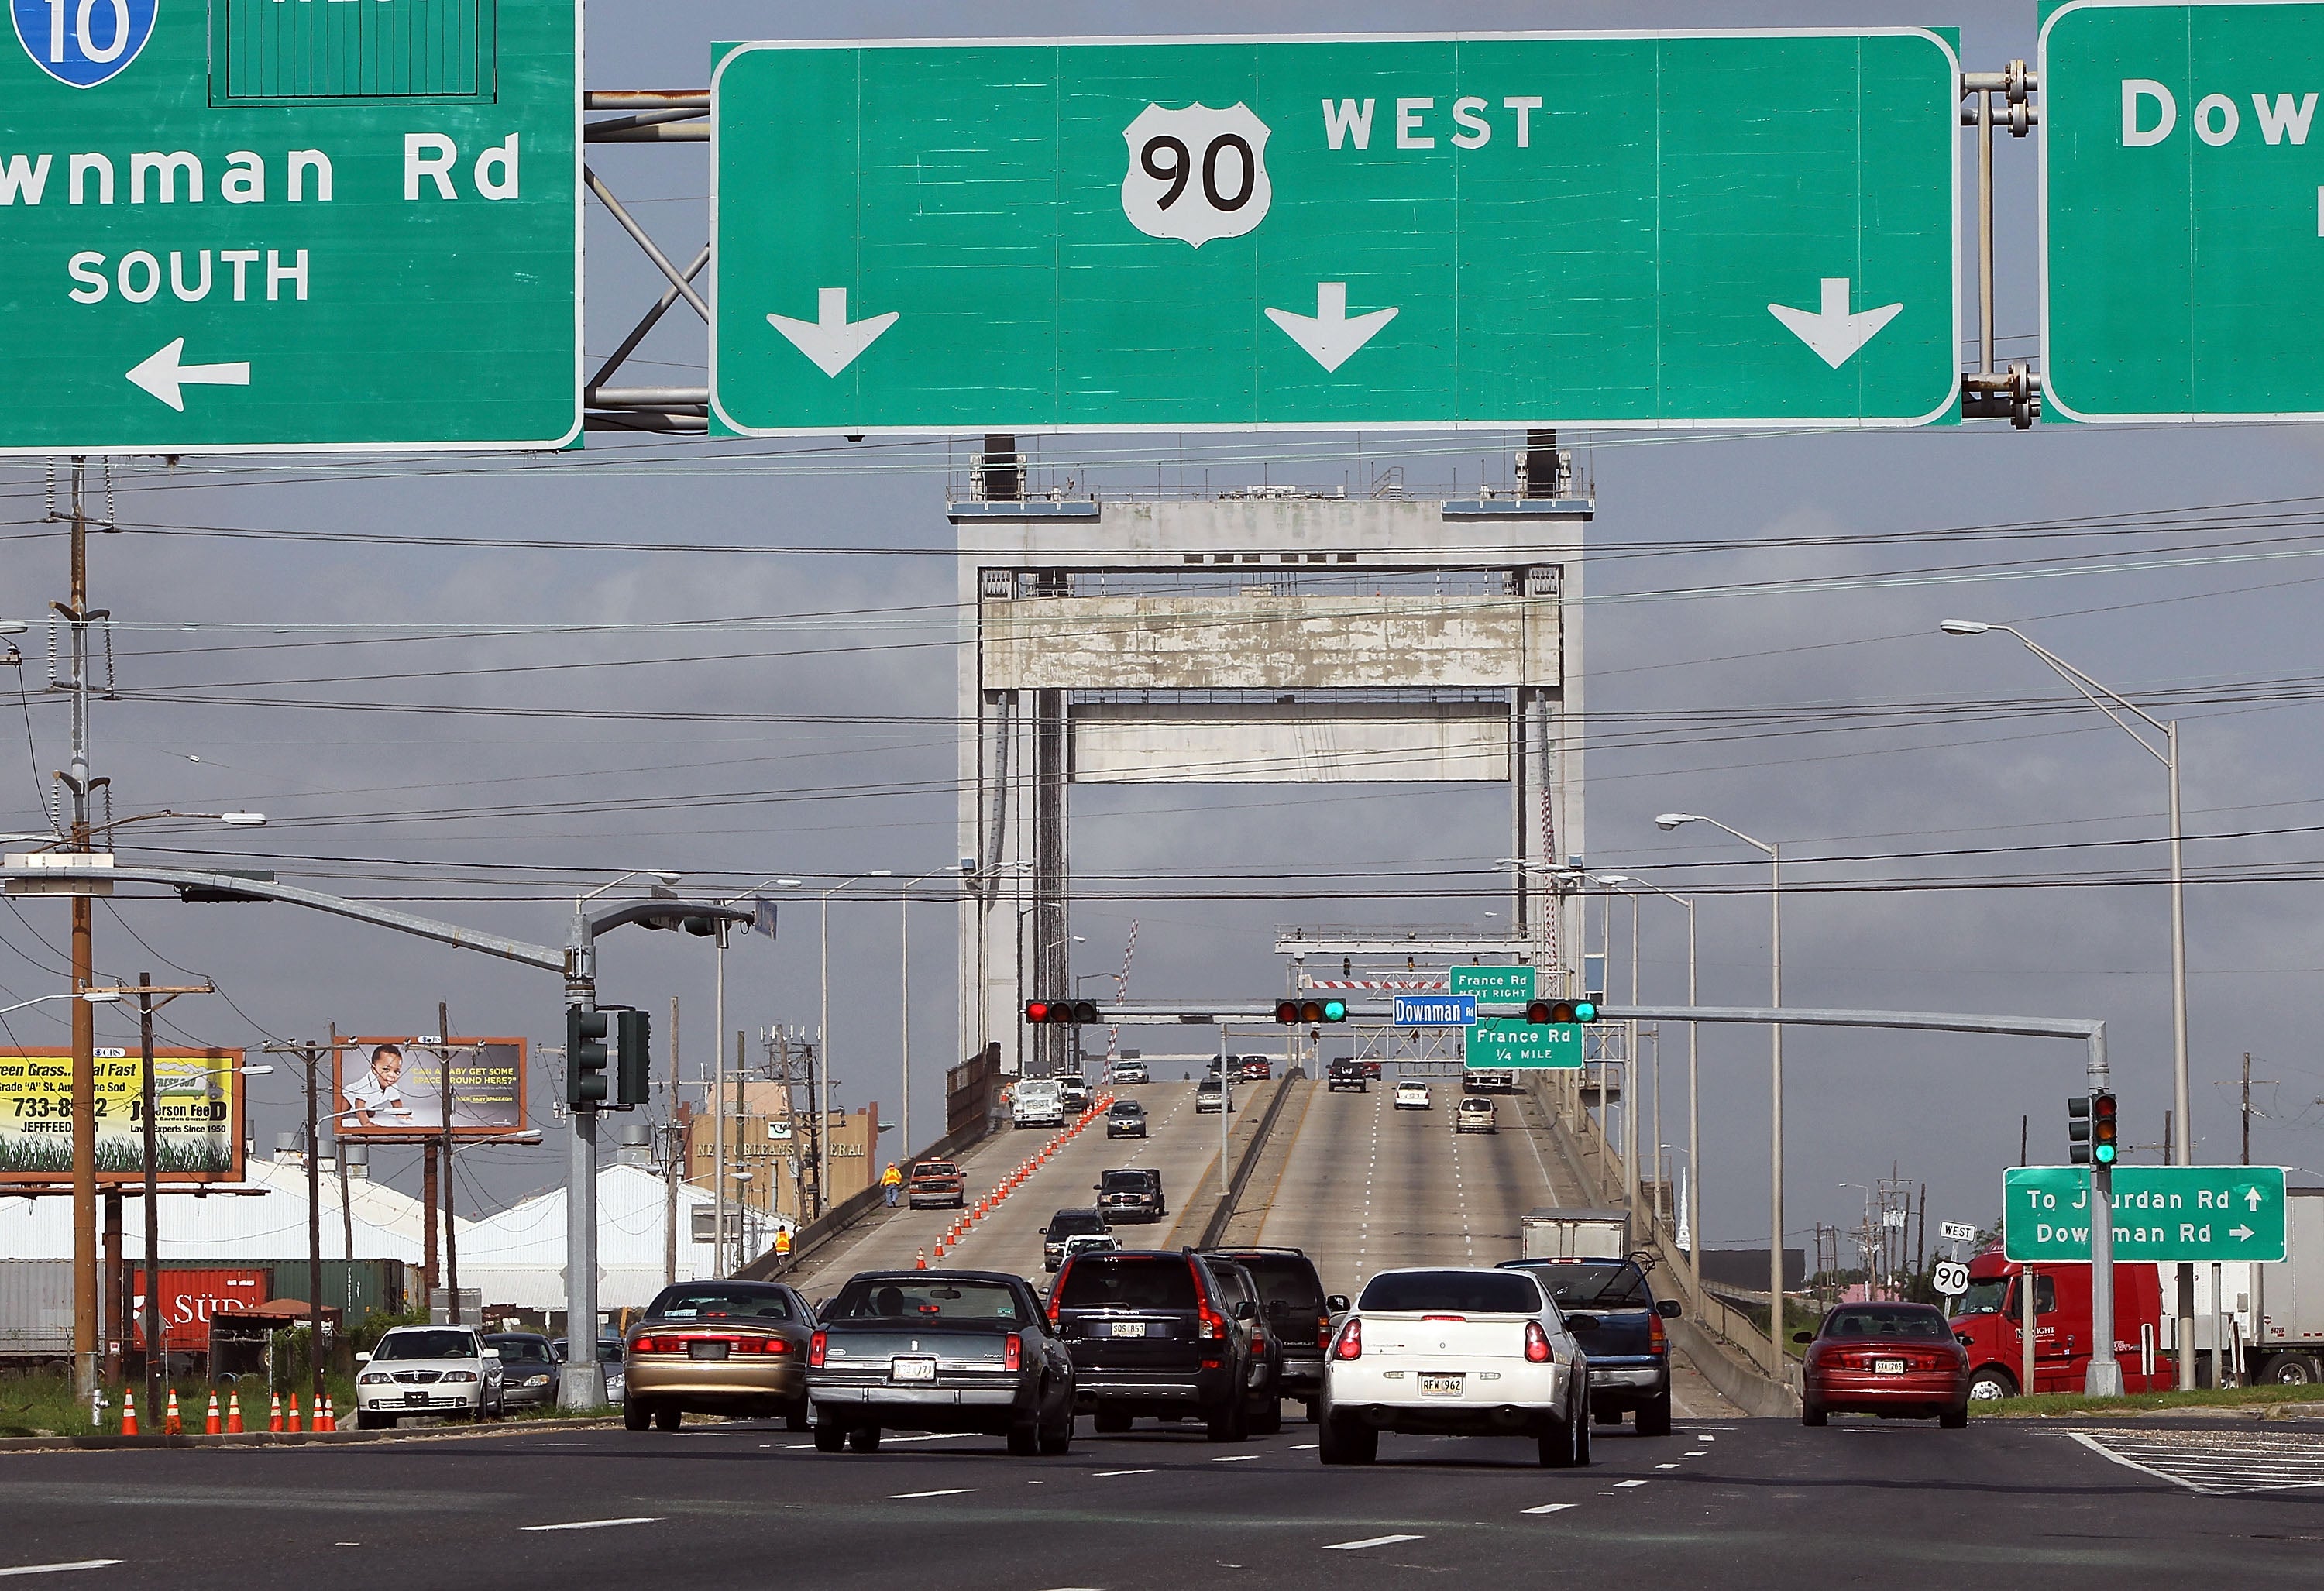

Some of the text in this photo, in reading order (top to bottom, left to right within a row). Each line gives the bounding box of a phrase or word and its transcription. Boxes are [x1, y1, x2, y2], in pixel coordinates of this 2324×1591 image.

[43, 0, 130, 64] 10
[1322, 95, 1543, 150] WEST
[404, 132, 519, 201] Rd
[1140, 132, 1256, 212] 90
[67, 249, 309, 305] SOUTH
[1459, 975, 1528, 986] France Rd
[1395, 999, 1474, 1022] Downman Rd
[1477, 1029, 1571, 1043] France Rd
[1521, 1050, 1552, 1060] MILE
[108, 1063, 137, 1077] Fast
[469, 1067, 487, 1076] GET
[489, 1067, 514, 1076] SOME
[107, 1082, 125, 1092] Sod
[413, 1076, 441, 1084] SPACE
[449, 1076, 482, 1084] ROUND
[12, 1098, 108, 1118] 733-82
[184, 1125, 205, 1133] Since
[208, 1125, 226, 1133] 1950
[734, 1143, 795, 1156] RLEANS
[2027, 1190, 2229, 1209] To Jurdan Rd
[1945, 1225, 1972, 1239] WEST
[2037, 1223, 2211, 1242] Dowman Rd
[1937, 1267, 1965, 1289] 90
[1445, 1380, 1461, 1391] 962
